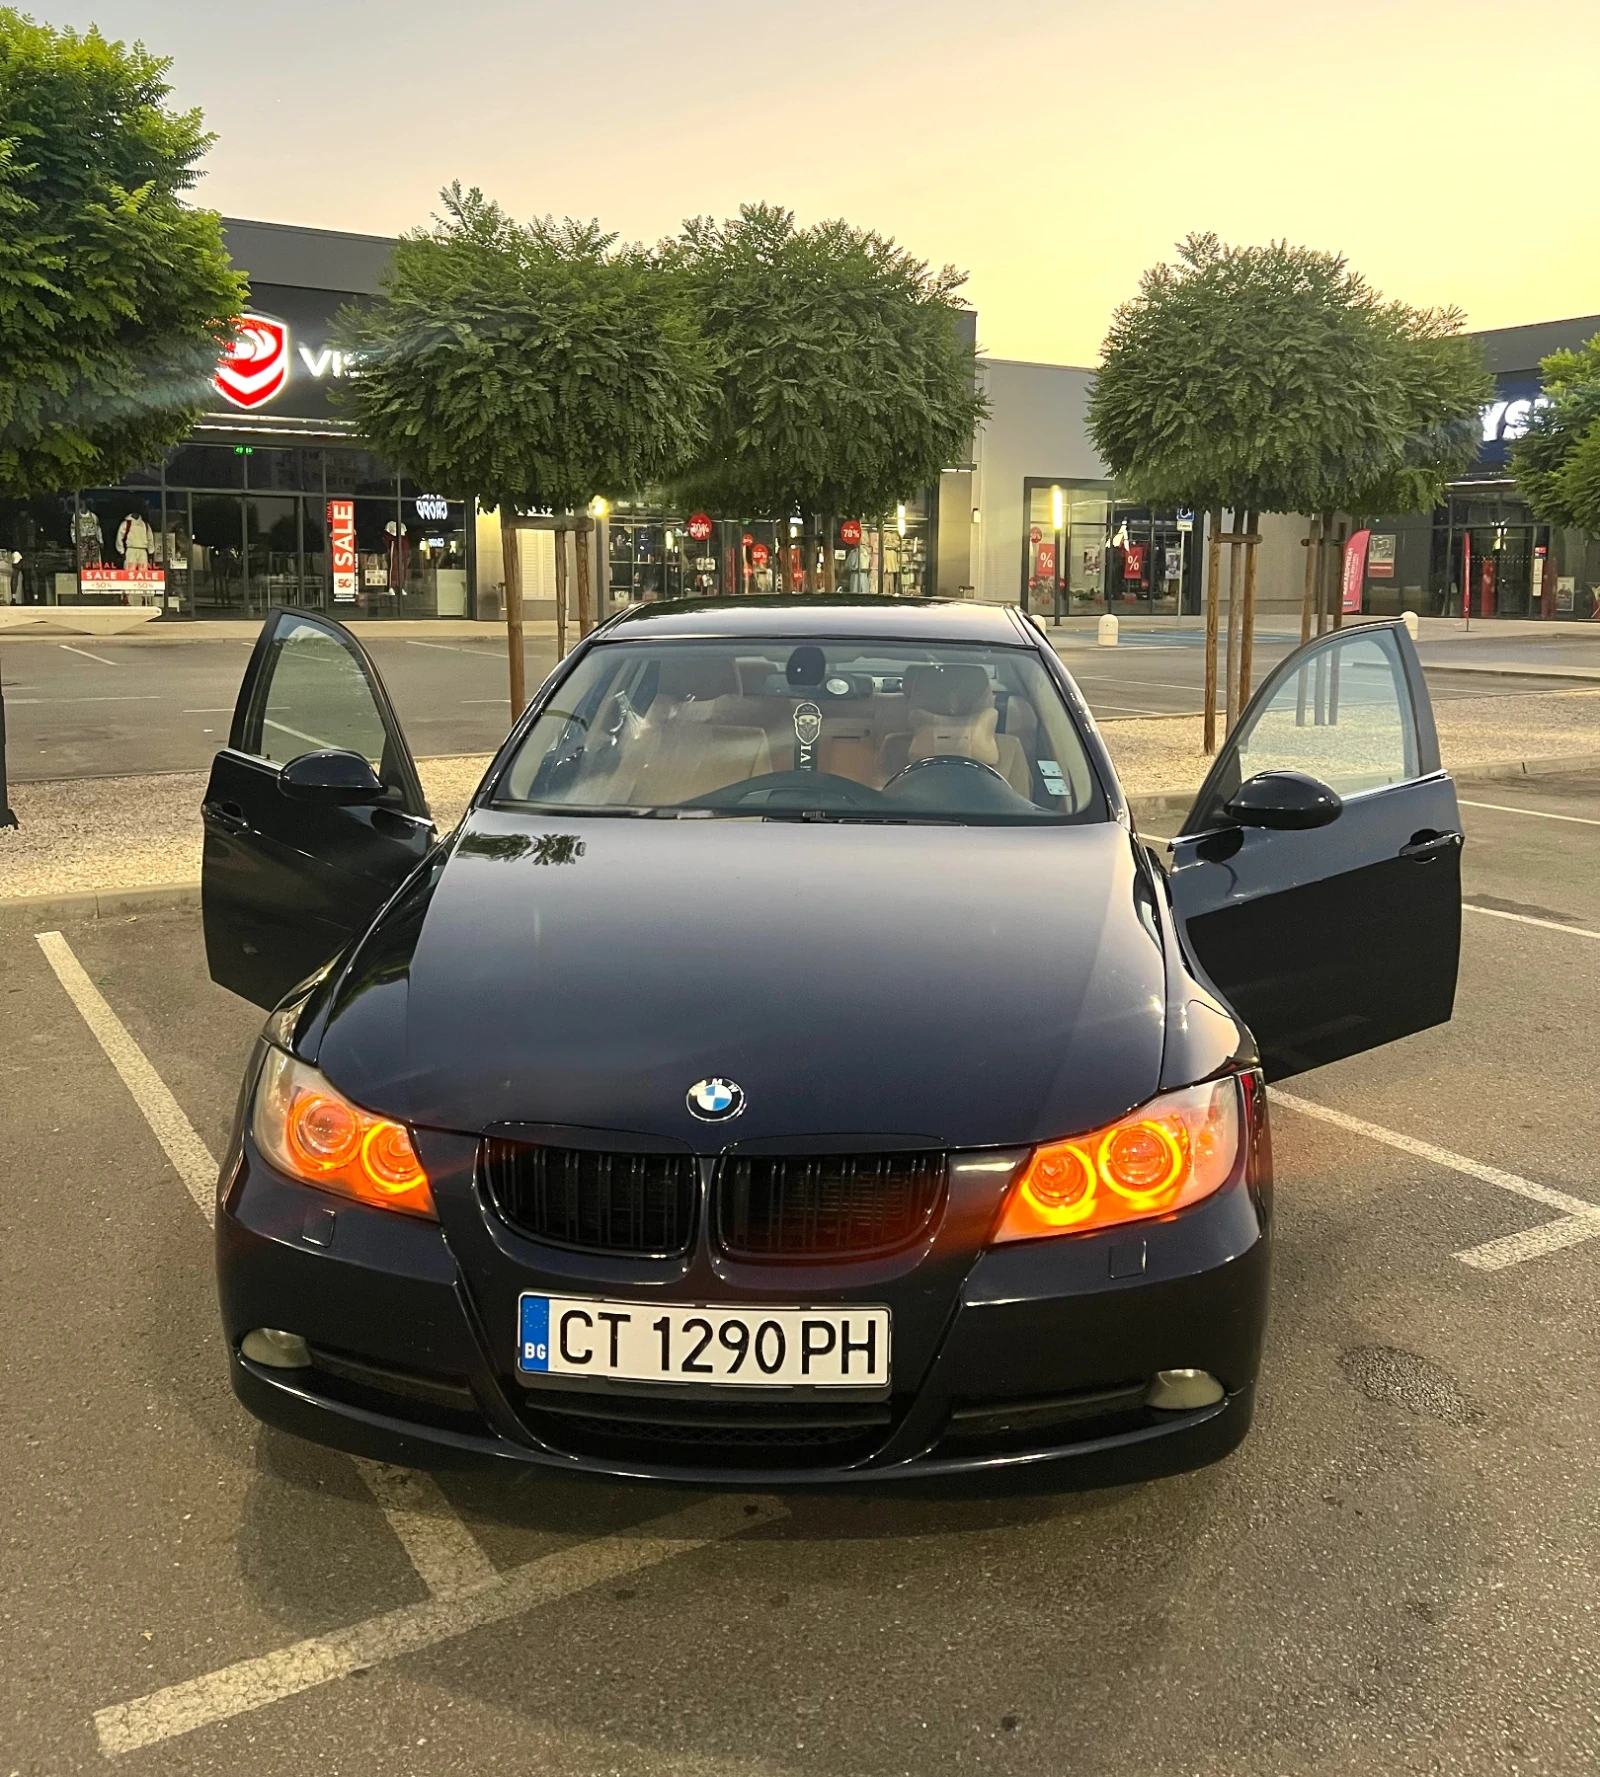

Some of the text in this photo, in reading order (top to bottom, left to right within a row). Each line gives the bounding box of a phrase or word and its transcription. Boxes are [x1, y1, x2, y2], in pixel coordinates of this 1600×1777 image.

[334, 504, 354, 567] SALE
[1040, 551, 1053, 568] %
[1127, 555, 1140, 571] %
[86, 571, 159, 580] SALE SALE
[524, 1342, 546, 1361] BG
[559, 1310, 876, 1375] CT 1290 PH
